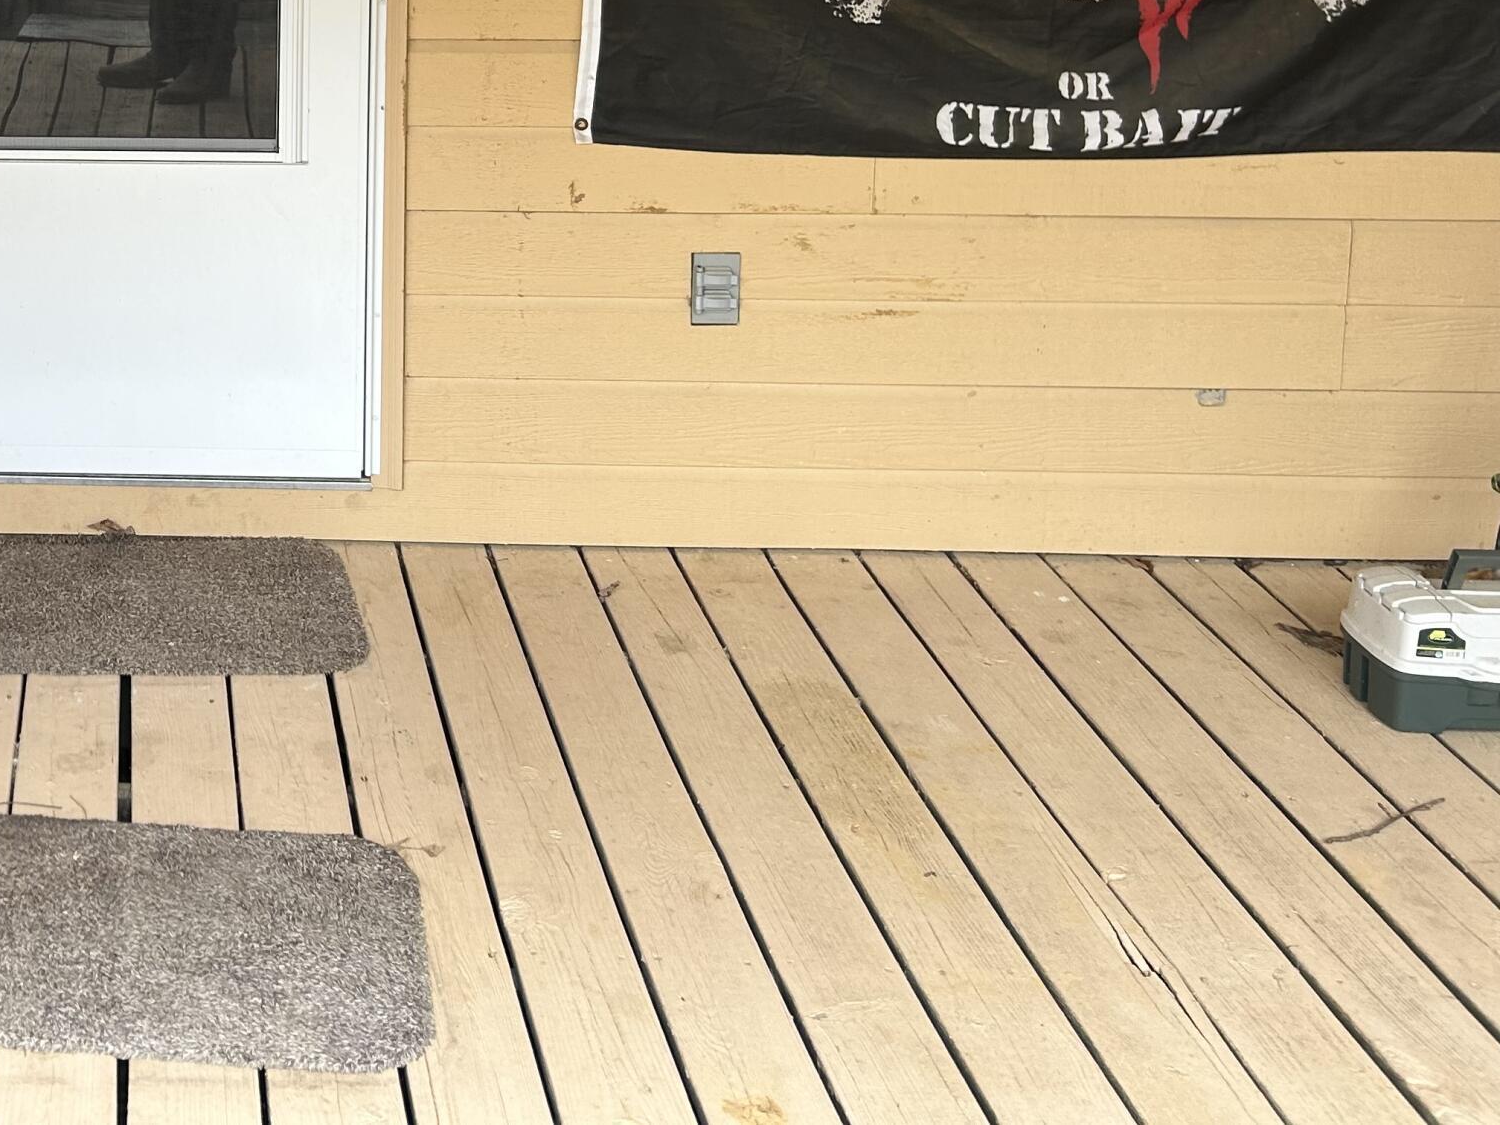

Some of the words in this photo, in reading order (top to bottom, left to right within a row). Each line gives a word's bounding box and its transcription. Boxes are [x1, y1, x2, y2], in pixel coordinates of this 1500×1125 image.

[1058, 71, 1115, 101] OR
[935, 101, 1061, 152] CUT
[1080, 106, 1243, 152] BAIT
